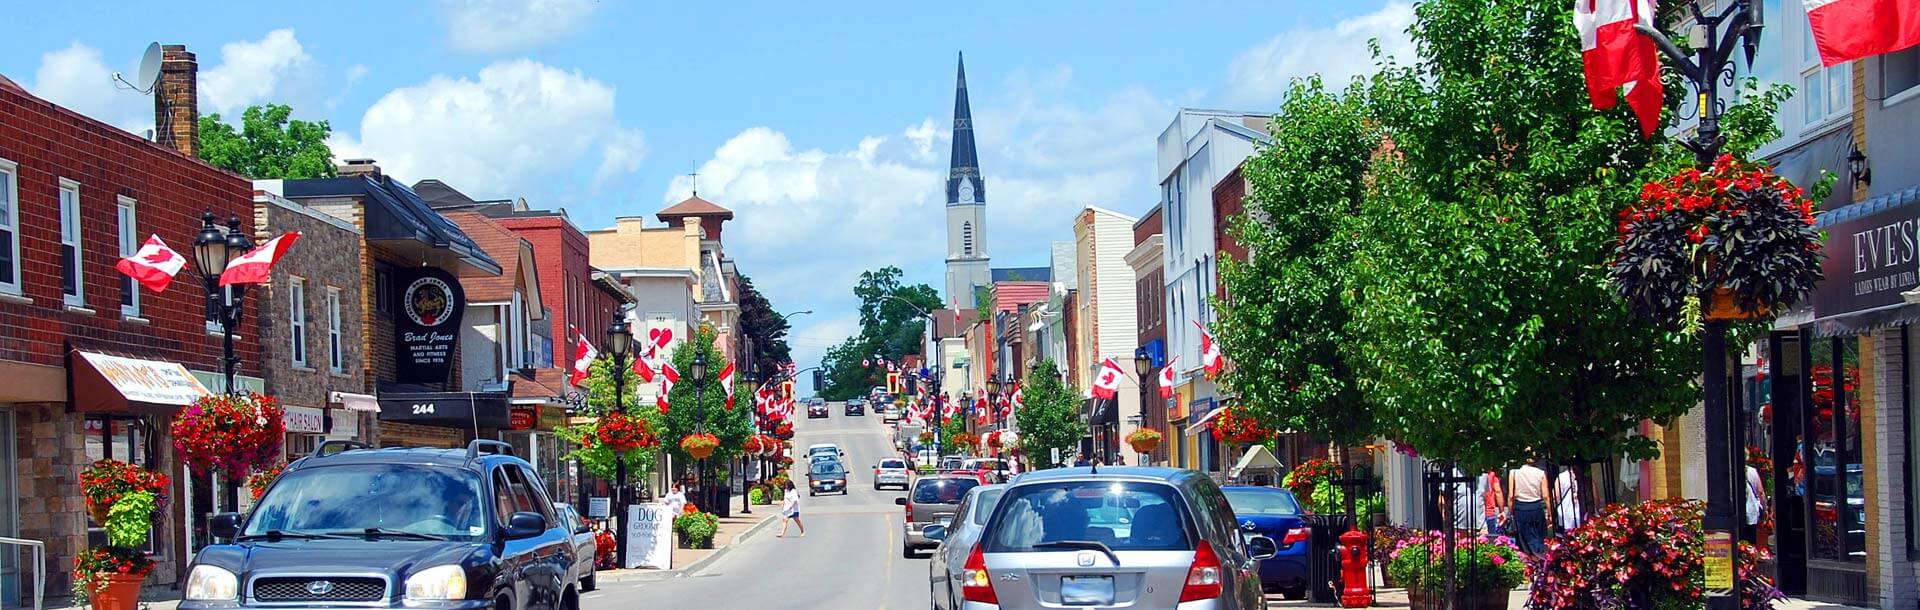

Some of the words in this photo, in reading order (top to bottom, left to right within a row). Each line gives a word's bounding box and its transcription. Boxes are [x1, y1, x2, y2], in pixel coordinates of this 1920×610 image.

[1853, 219, 1914, 273] EVE'S
[1855, 280, 1873, 296] LADIES
[1873, 276, 1889, 291] WEAR
[1890, 274, 1898, 289] BY
[1898, 271, 1917, 287] LINDA
[404, 332, 428, 342] Brad
[429, 331, 454, 344] Jones
[412, 403, 435, 415] 244
[303, 413, 321, 432] SALON
[638, 507, 663, 522] DOG
